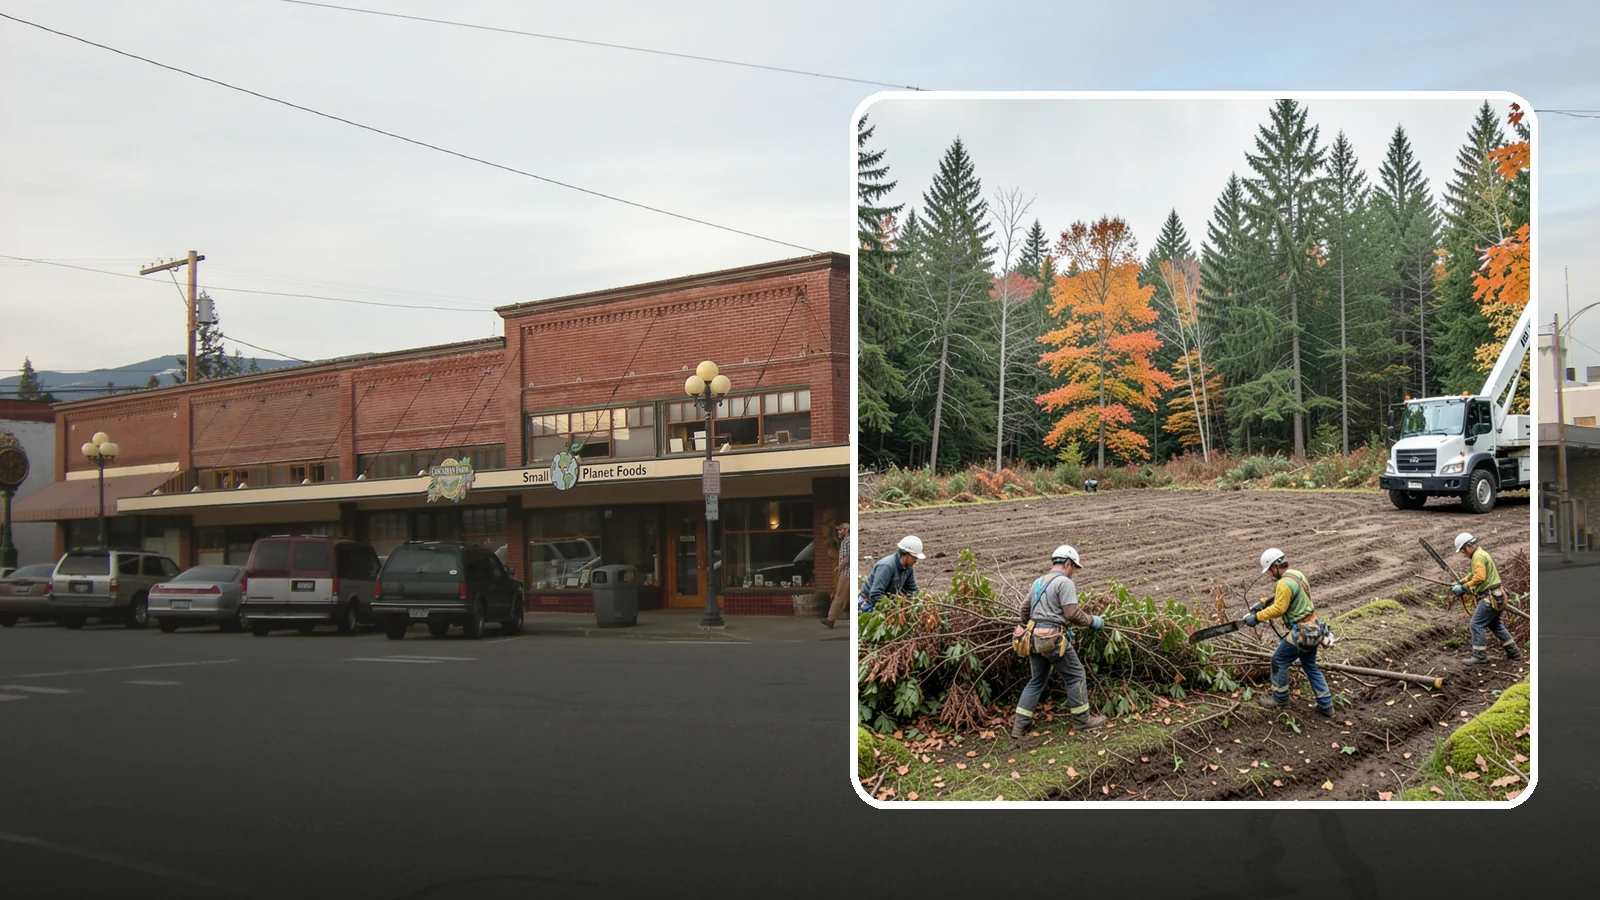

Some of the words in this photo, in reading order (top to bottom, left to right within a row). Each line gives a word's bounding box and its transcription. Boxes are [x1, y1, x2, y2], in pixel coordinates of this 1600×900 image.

[523, 471, 548, 482] Small
[583, 468, 614, 479] Planet
[617, 464, 646, 476] Foods
